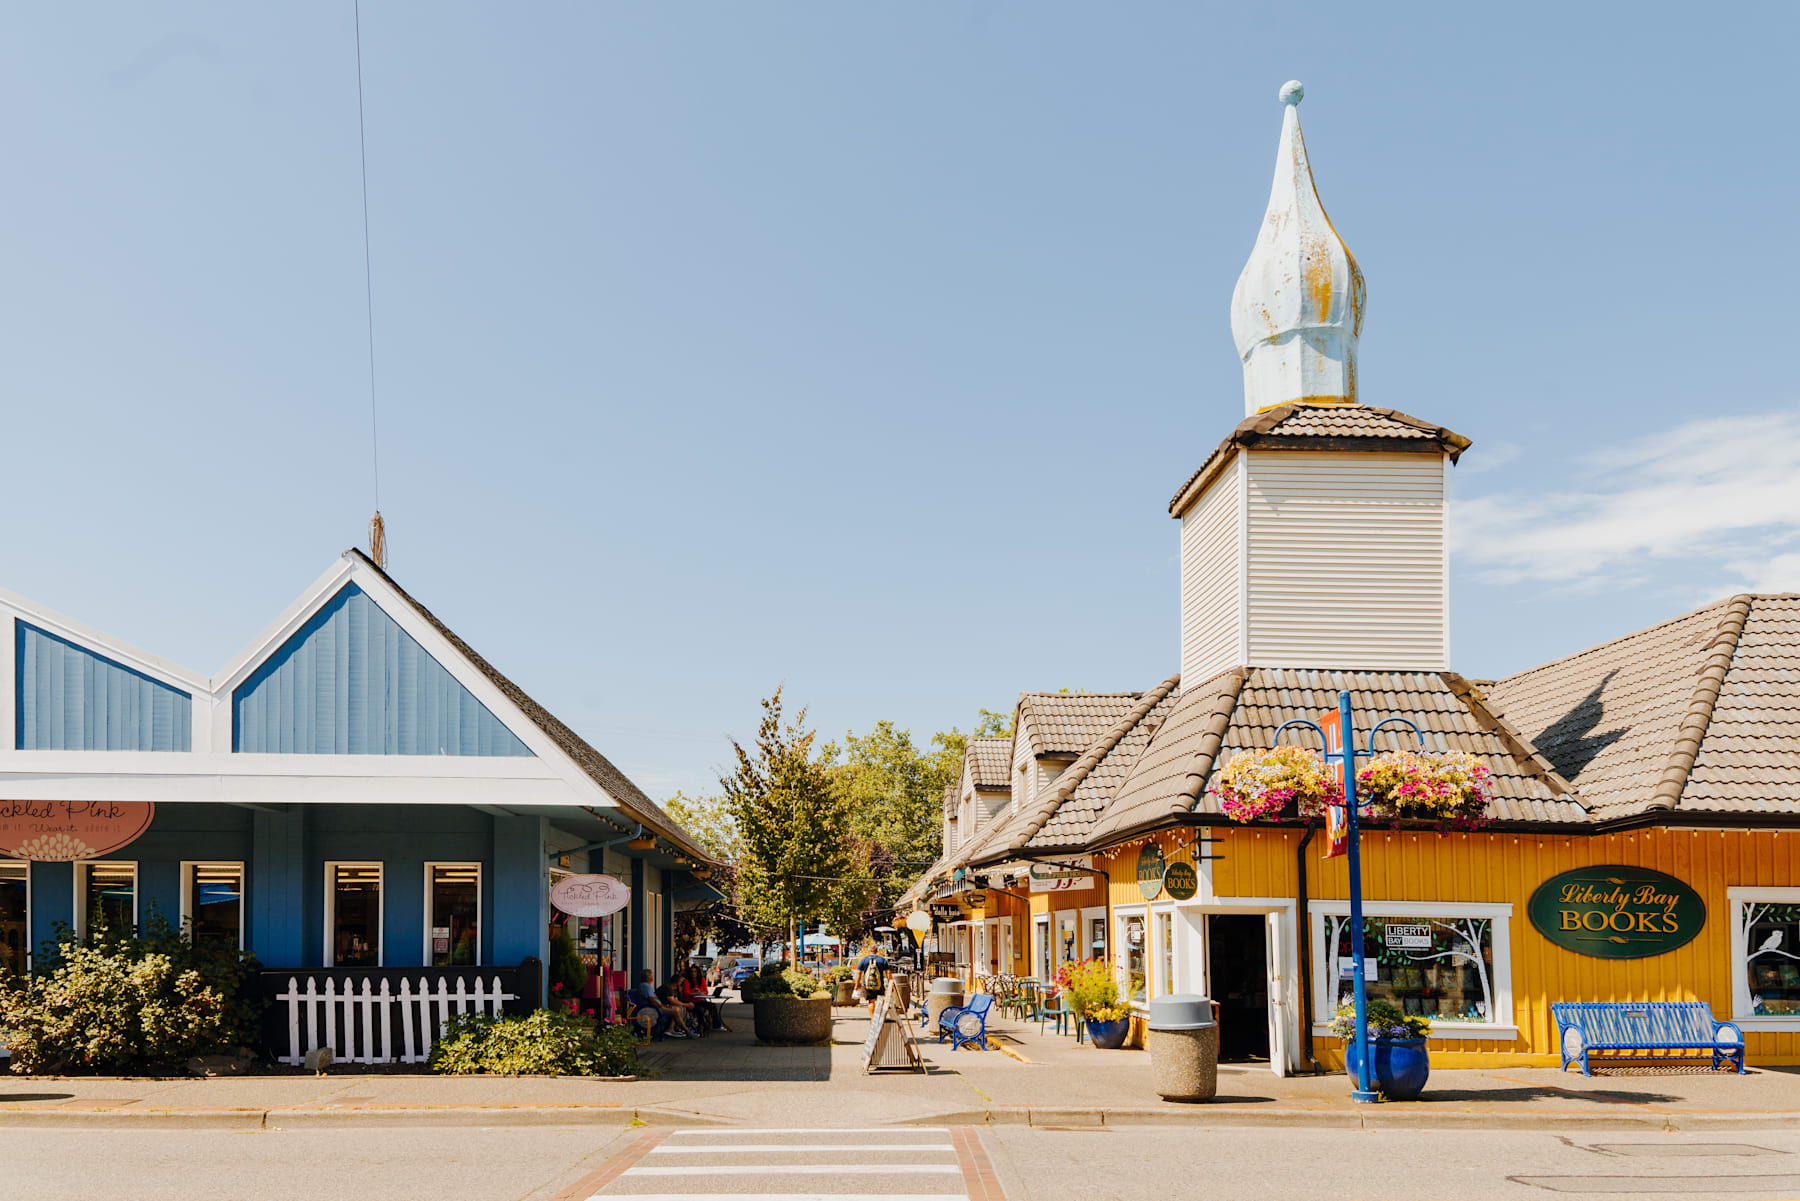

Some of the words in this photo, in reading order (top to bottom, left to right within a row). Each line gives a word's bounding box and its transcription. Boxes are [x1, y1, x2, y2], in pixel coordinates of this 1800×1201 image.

[0, 800, 55, 819] ckled
[59, 800, 126, 820] Pink
[1168, 877, 1196, 889] BOOKS
[1558, 884, 1631, 912] Liberty
[1633, 885, 1680, 914] Bay
[1559, 910, 1679, 933] BOOKS
[1388, 926, 1428, 936] LIBERTY
[1338, 941, 1370, 955] opn
[1388, 937, 1402, 945] BAY
[1404, 937, 1429, 945] BOOKS
